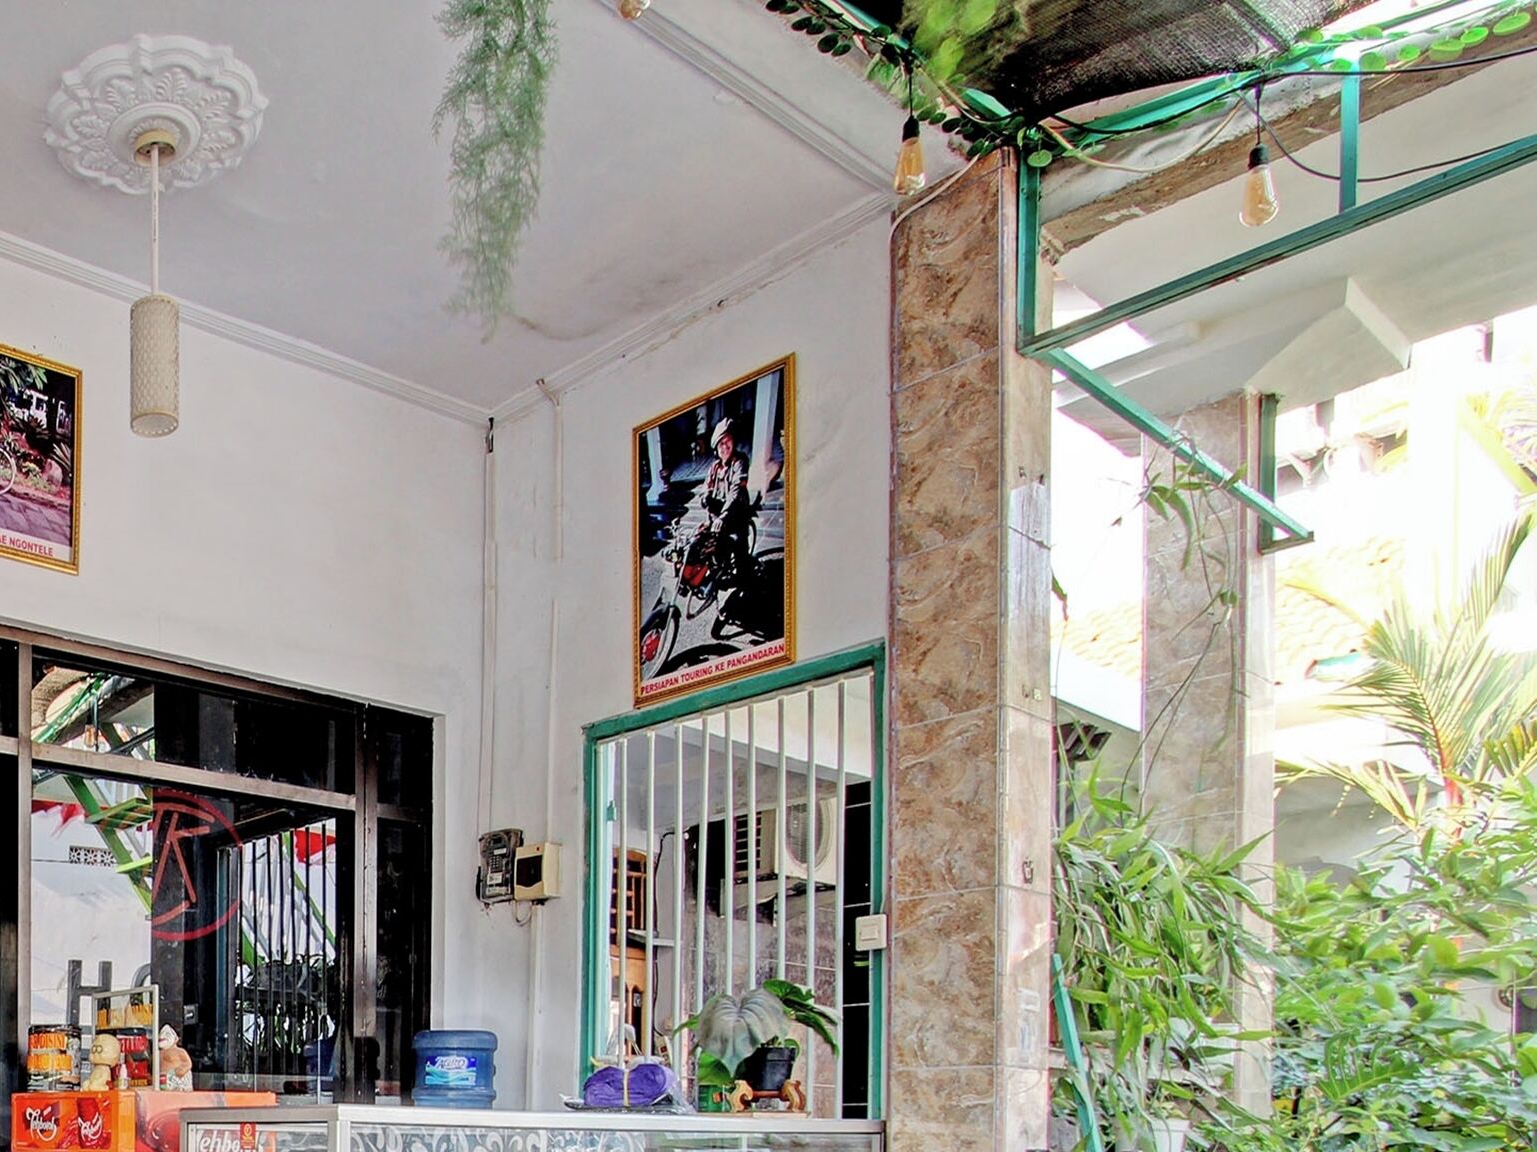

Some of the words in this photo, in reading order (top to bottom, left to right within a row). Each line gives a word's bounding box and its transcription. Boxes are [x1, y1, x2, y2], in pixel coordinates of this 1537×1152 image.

[9, 537, 54, 557] NGONTELE
[640, 677, 679, 695] PERSIAPAN
[680, 667, 713, 683] TOURING
[715, 662, 725, 673] KE
[727, 645, 785, 670] PANGANDARAN
